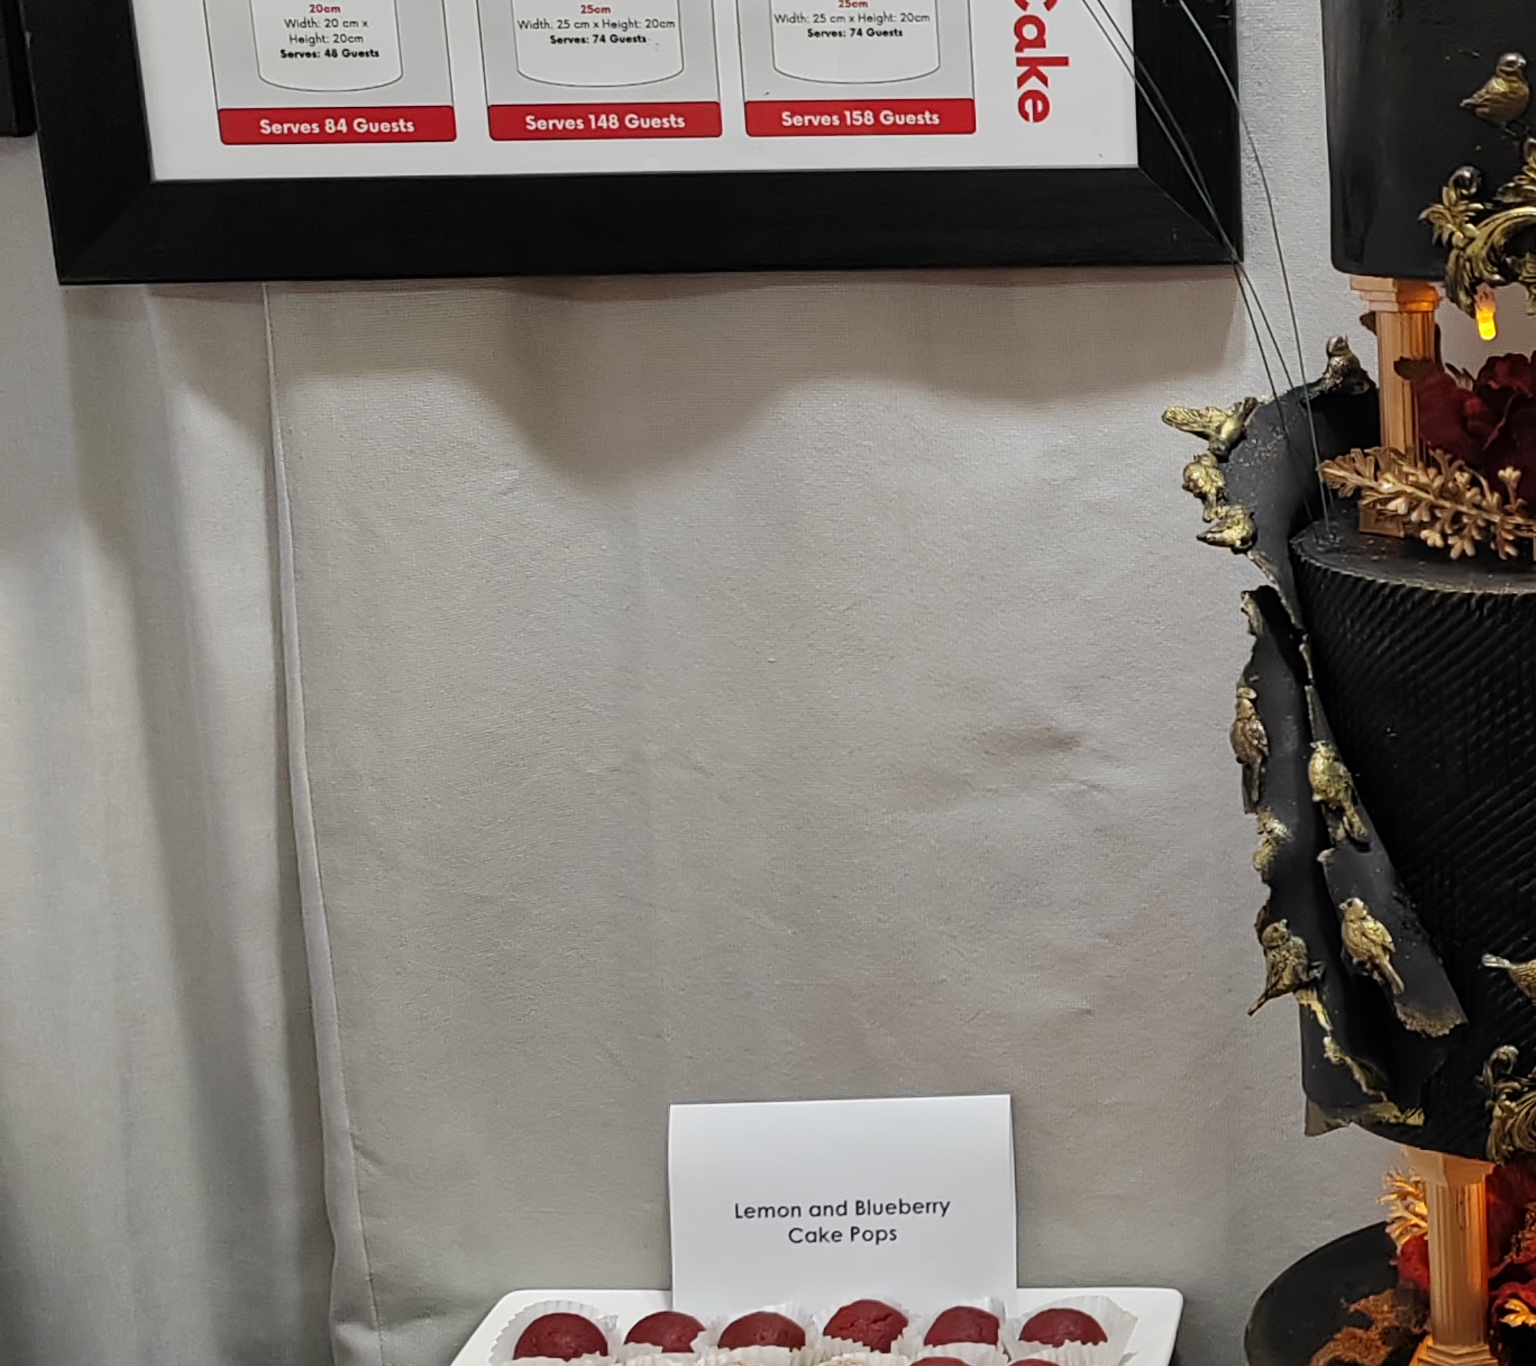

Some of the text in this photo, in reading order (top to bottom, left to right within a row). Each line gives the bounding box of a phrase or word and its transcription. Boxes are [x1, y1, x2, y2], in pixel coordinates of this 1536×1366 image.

[308, 3, 342, 14] 20cm
[580, 4, 612, 15] 25cm
[516, 17, 676, 33] Width: 25 Height: 20cm
[773, 10, 931, 27] Width: 25 Height: 20cm
[549, 33, 647, 45] Serves: 74 Guests
[806, 27, 904, 39] Serves: 74 Guests
[279, 47, 380, 59] Serves: 48 Guests
[259, 117, 415, 135] Serves 84 Guests
[525, 113, 686, 131] Serves 148 Guests
[781, 109, 940, 127] Serves 158 Guests
[734, 1197, 952, 1220] Lemon and Blueberry
[787, 1225, 898, 1246] Cake Pops
